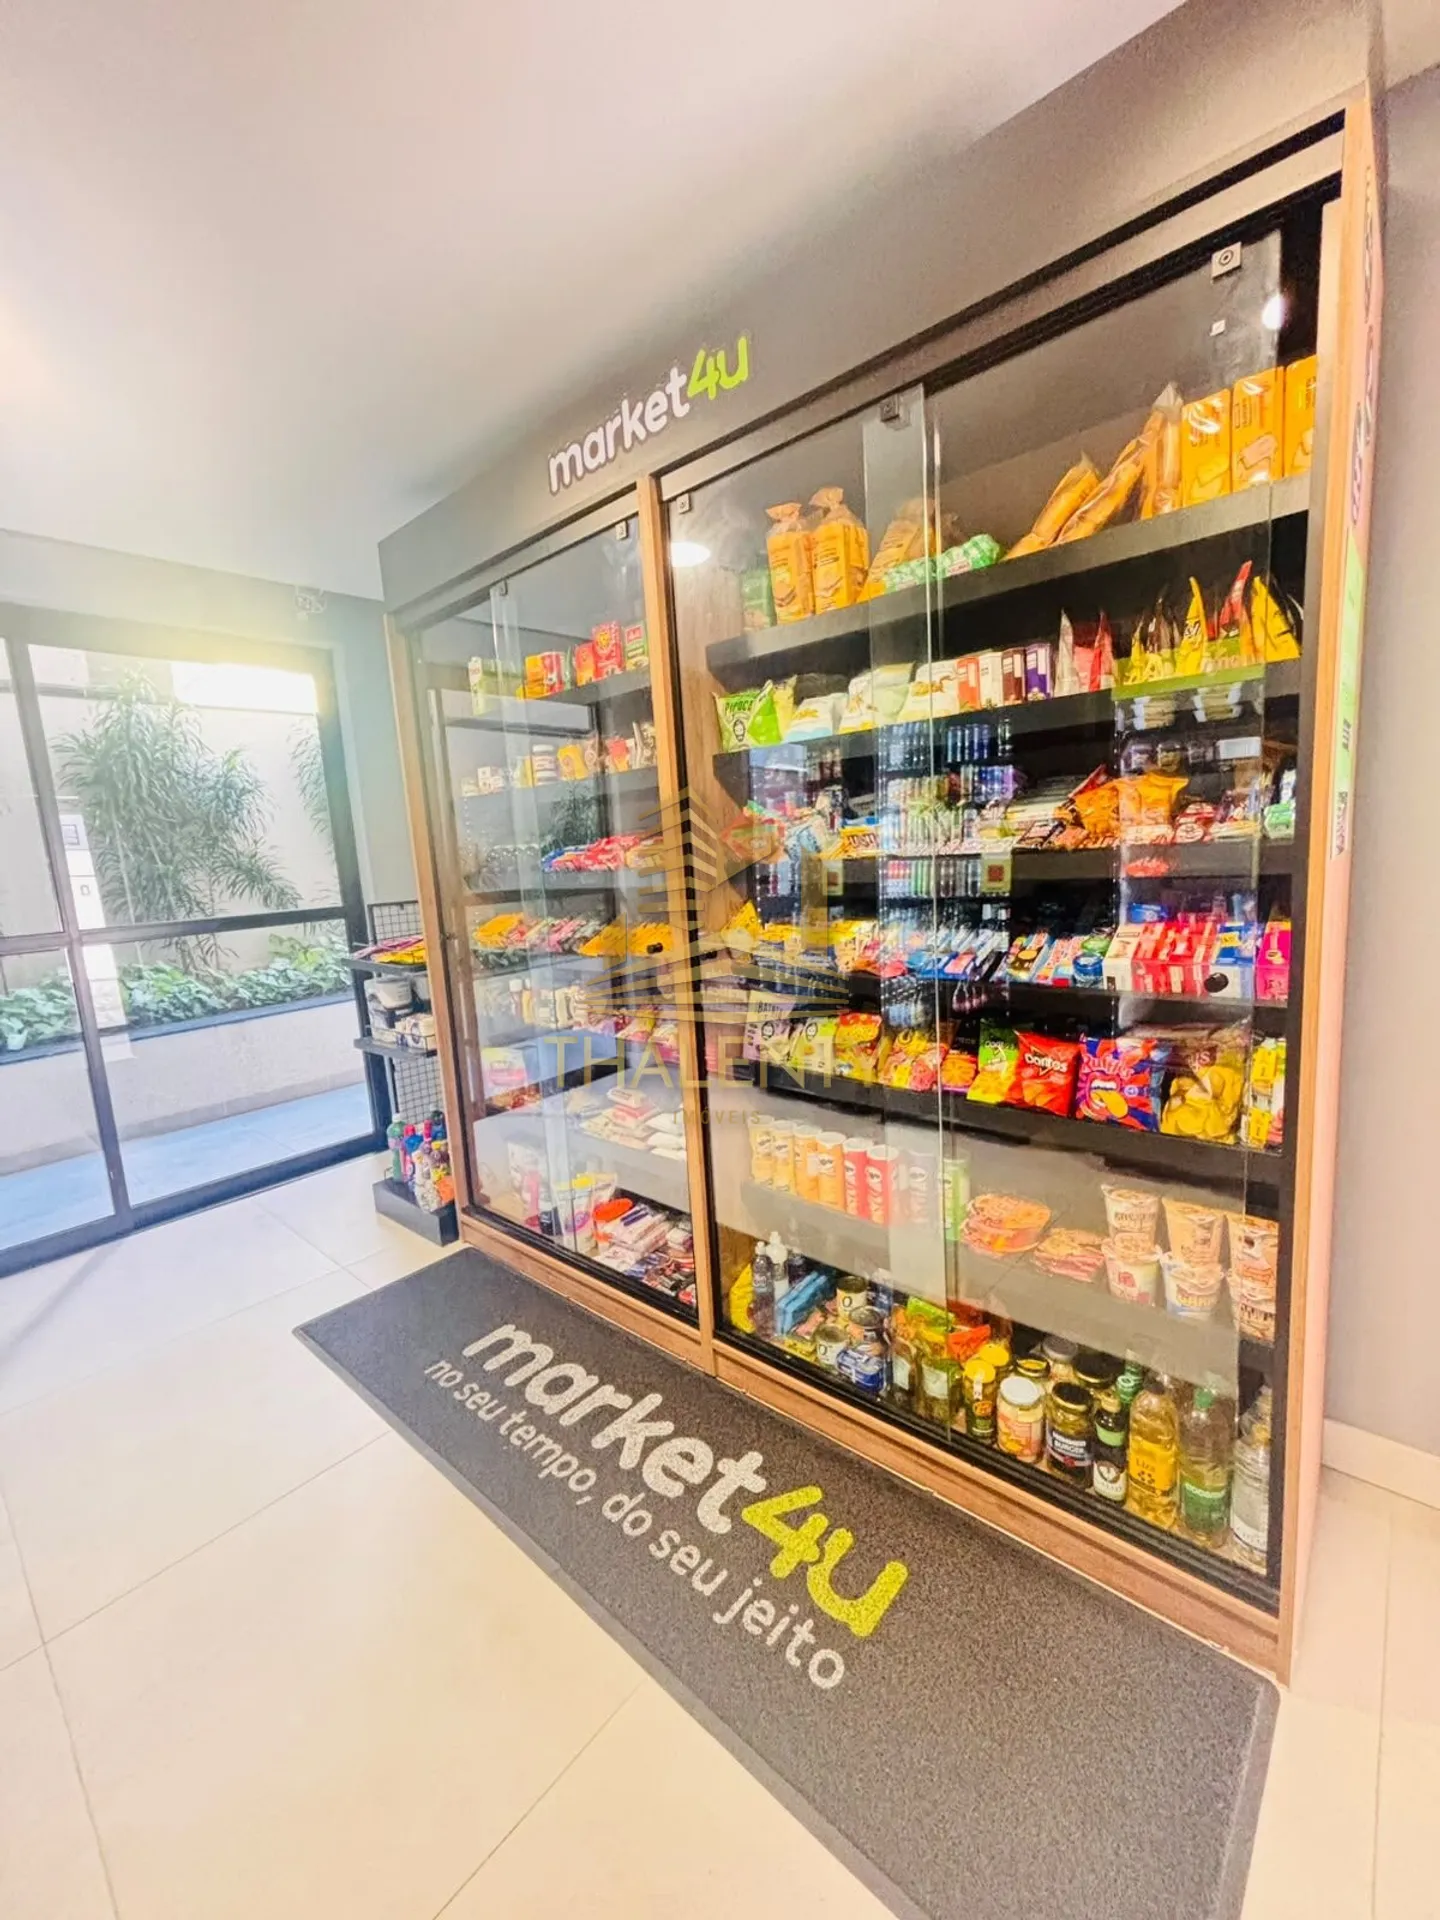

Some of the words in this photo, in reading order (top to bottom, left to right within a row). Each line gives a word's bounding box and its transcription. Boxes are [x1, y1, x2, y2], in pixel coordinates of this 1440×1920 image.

[424, 1358, 462, 1389] no
[453, 1379, 506, 1423] seu
[499, 1410, 598, 1506] tempo,
[601, 1491, 654, 1538] do
[648, 1528, 729, 1597] seu
[712, 1576, 845, 1689] jeito
